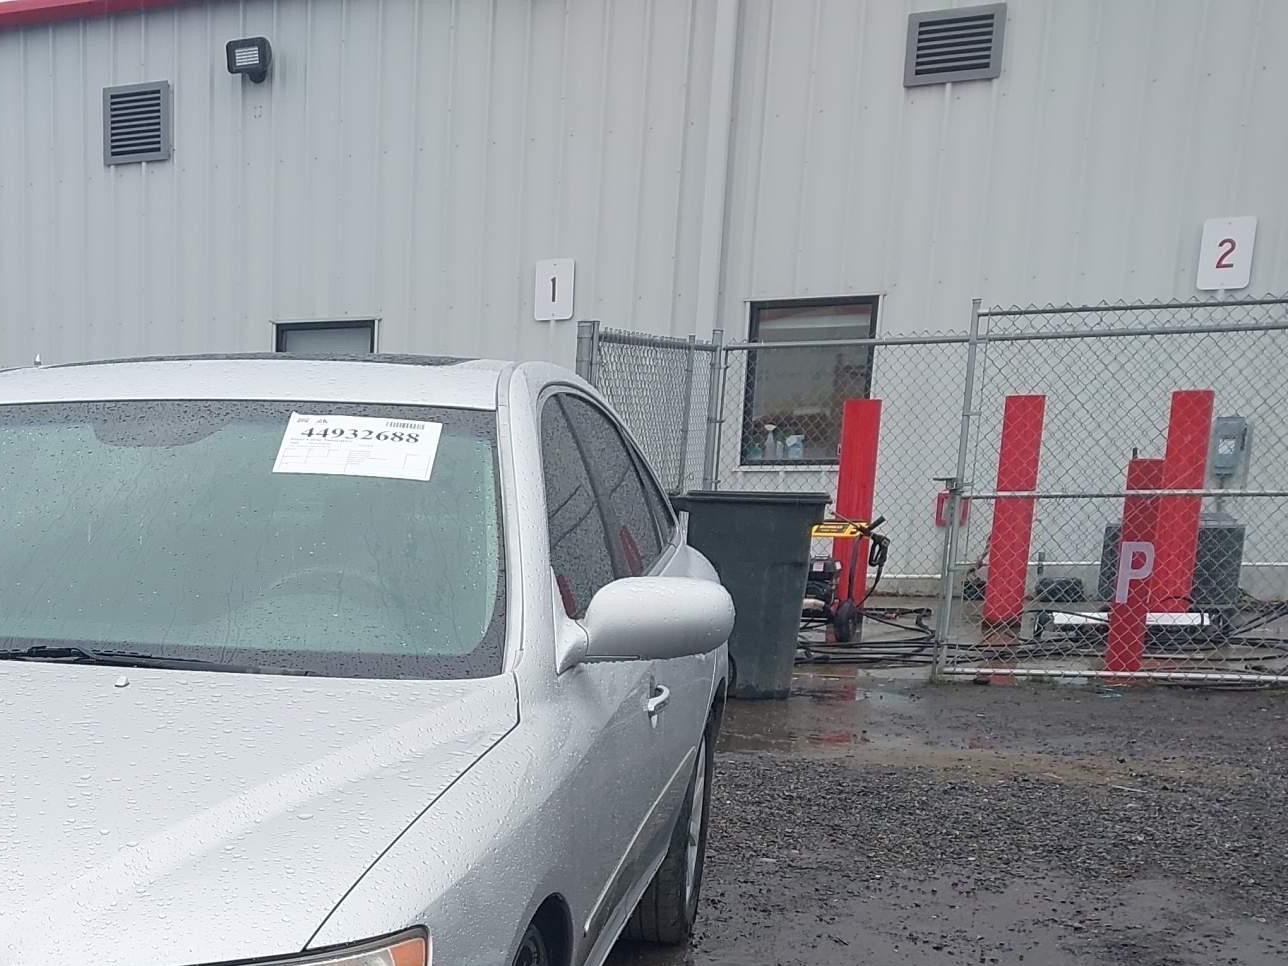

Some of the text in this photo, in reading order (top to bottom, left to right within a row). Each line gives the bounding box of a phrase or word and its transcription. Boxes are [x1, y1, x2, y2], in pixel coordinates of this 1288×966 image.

[1215, 238, 1237, 269] 2
[550, 276, 557, 303] 1
[300, 426, 421, 444] 44932688
[1115, 541, 1155, 603] P
